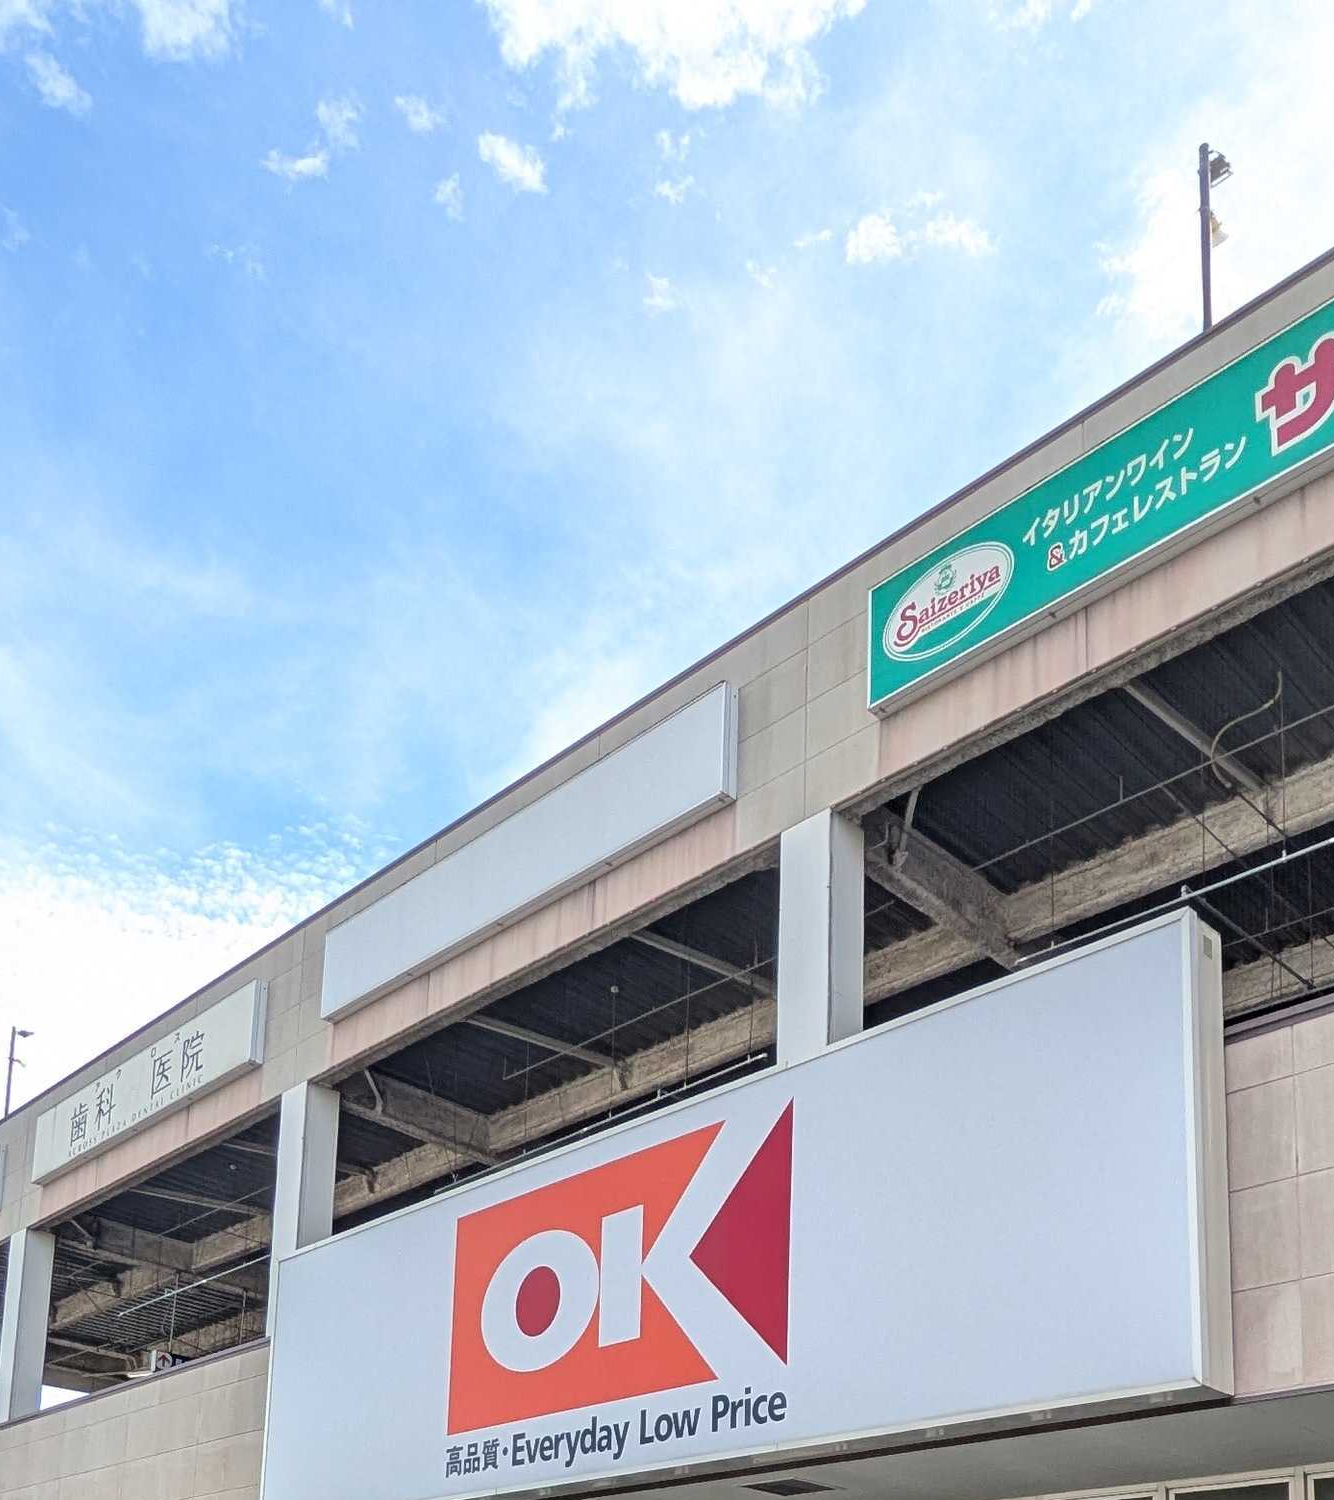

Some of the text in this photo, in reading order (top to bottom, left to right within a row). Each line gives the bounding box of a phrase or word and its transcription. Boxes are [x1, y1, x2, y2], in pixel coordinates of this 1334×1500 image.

[1022, 428, 1194, 546] イタリアンワイン
[893, 565, 1001, 647] Saizeriya
[70, 1030, 205, 1146] 歯科 医院
[131, 1099, 166, 1123] DENTAL
[170, 1074, 204, 1100] CLINIC
[479, 1100, 790, 1372] OK
[511, 1416, 630, 1468] Everyday
[639, 1407, 701, 1446] Low
[711, 1386, 788, 1433] Price
